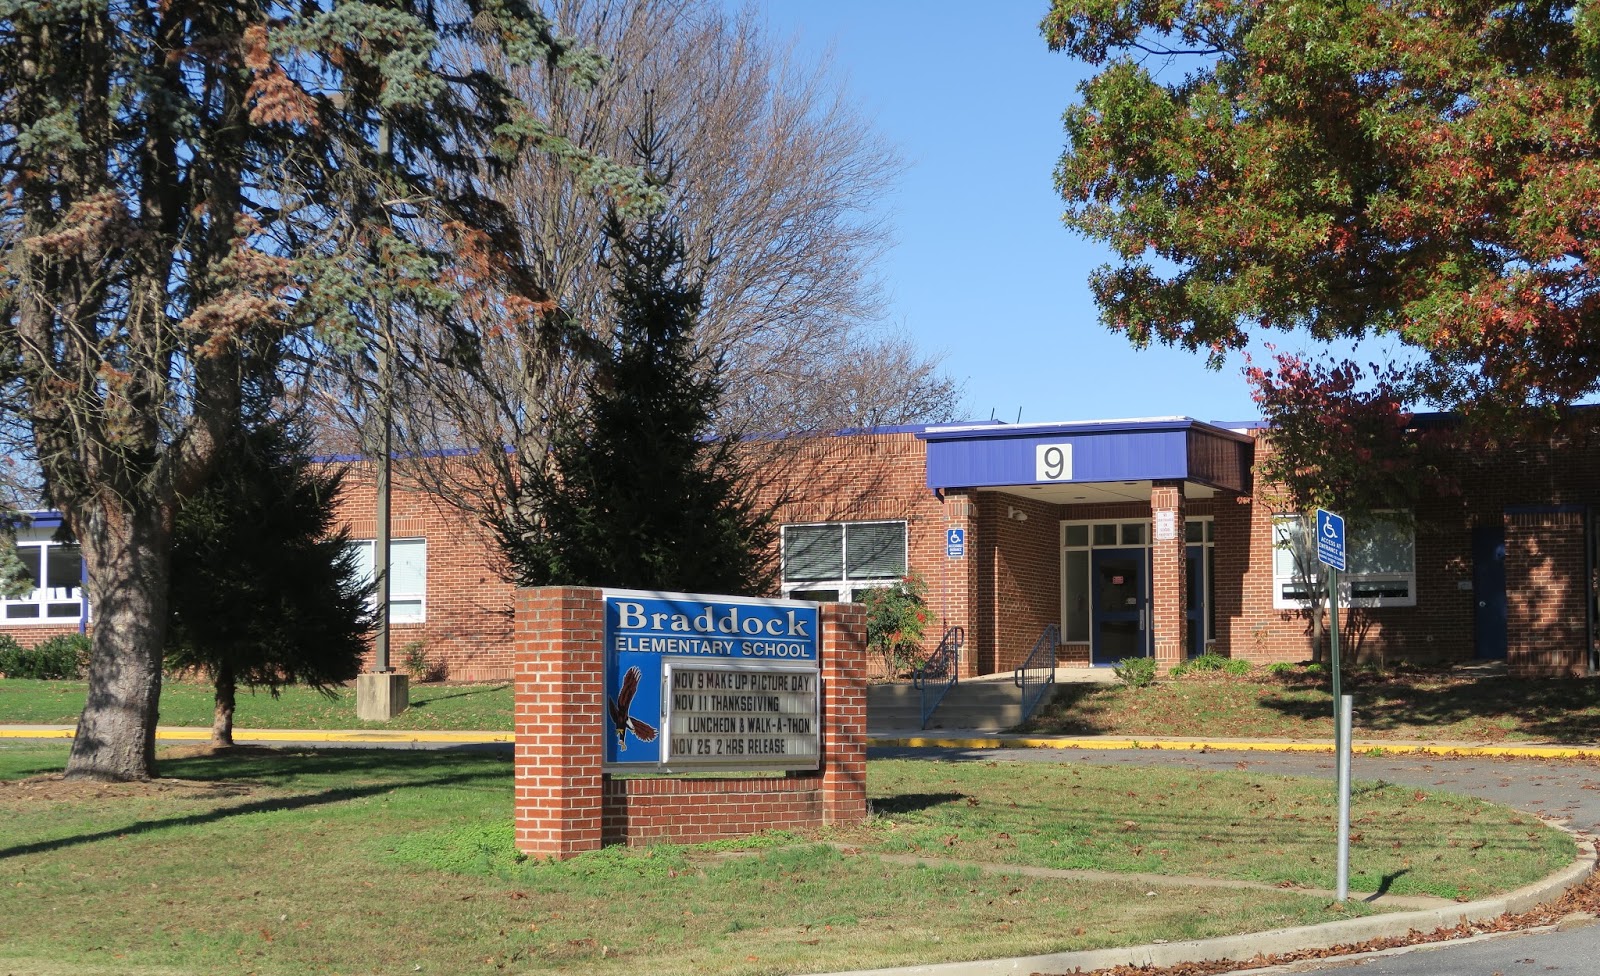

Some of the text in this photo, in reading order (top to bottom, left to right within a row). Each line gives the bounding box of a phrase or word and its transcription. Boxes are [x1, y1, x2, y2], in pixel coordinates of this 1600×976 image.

[1044, 447, 1064, 479] 9
[615, 601, 809, 637] Braddock
[615, 636, 810, 657] ELEMENTARY SCHOOL
[674, 673, 809, 691] NOV 9 MAKE UP PICTURE DAY
[674, 694, 779, 711] NOV 11 THANKSGIVING
[688, 717, 810, 733] LUNCHEON & WALK-A-THON
[672, 738, 785, 755] NOV 25 2 HRS RELEASE
